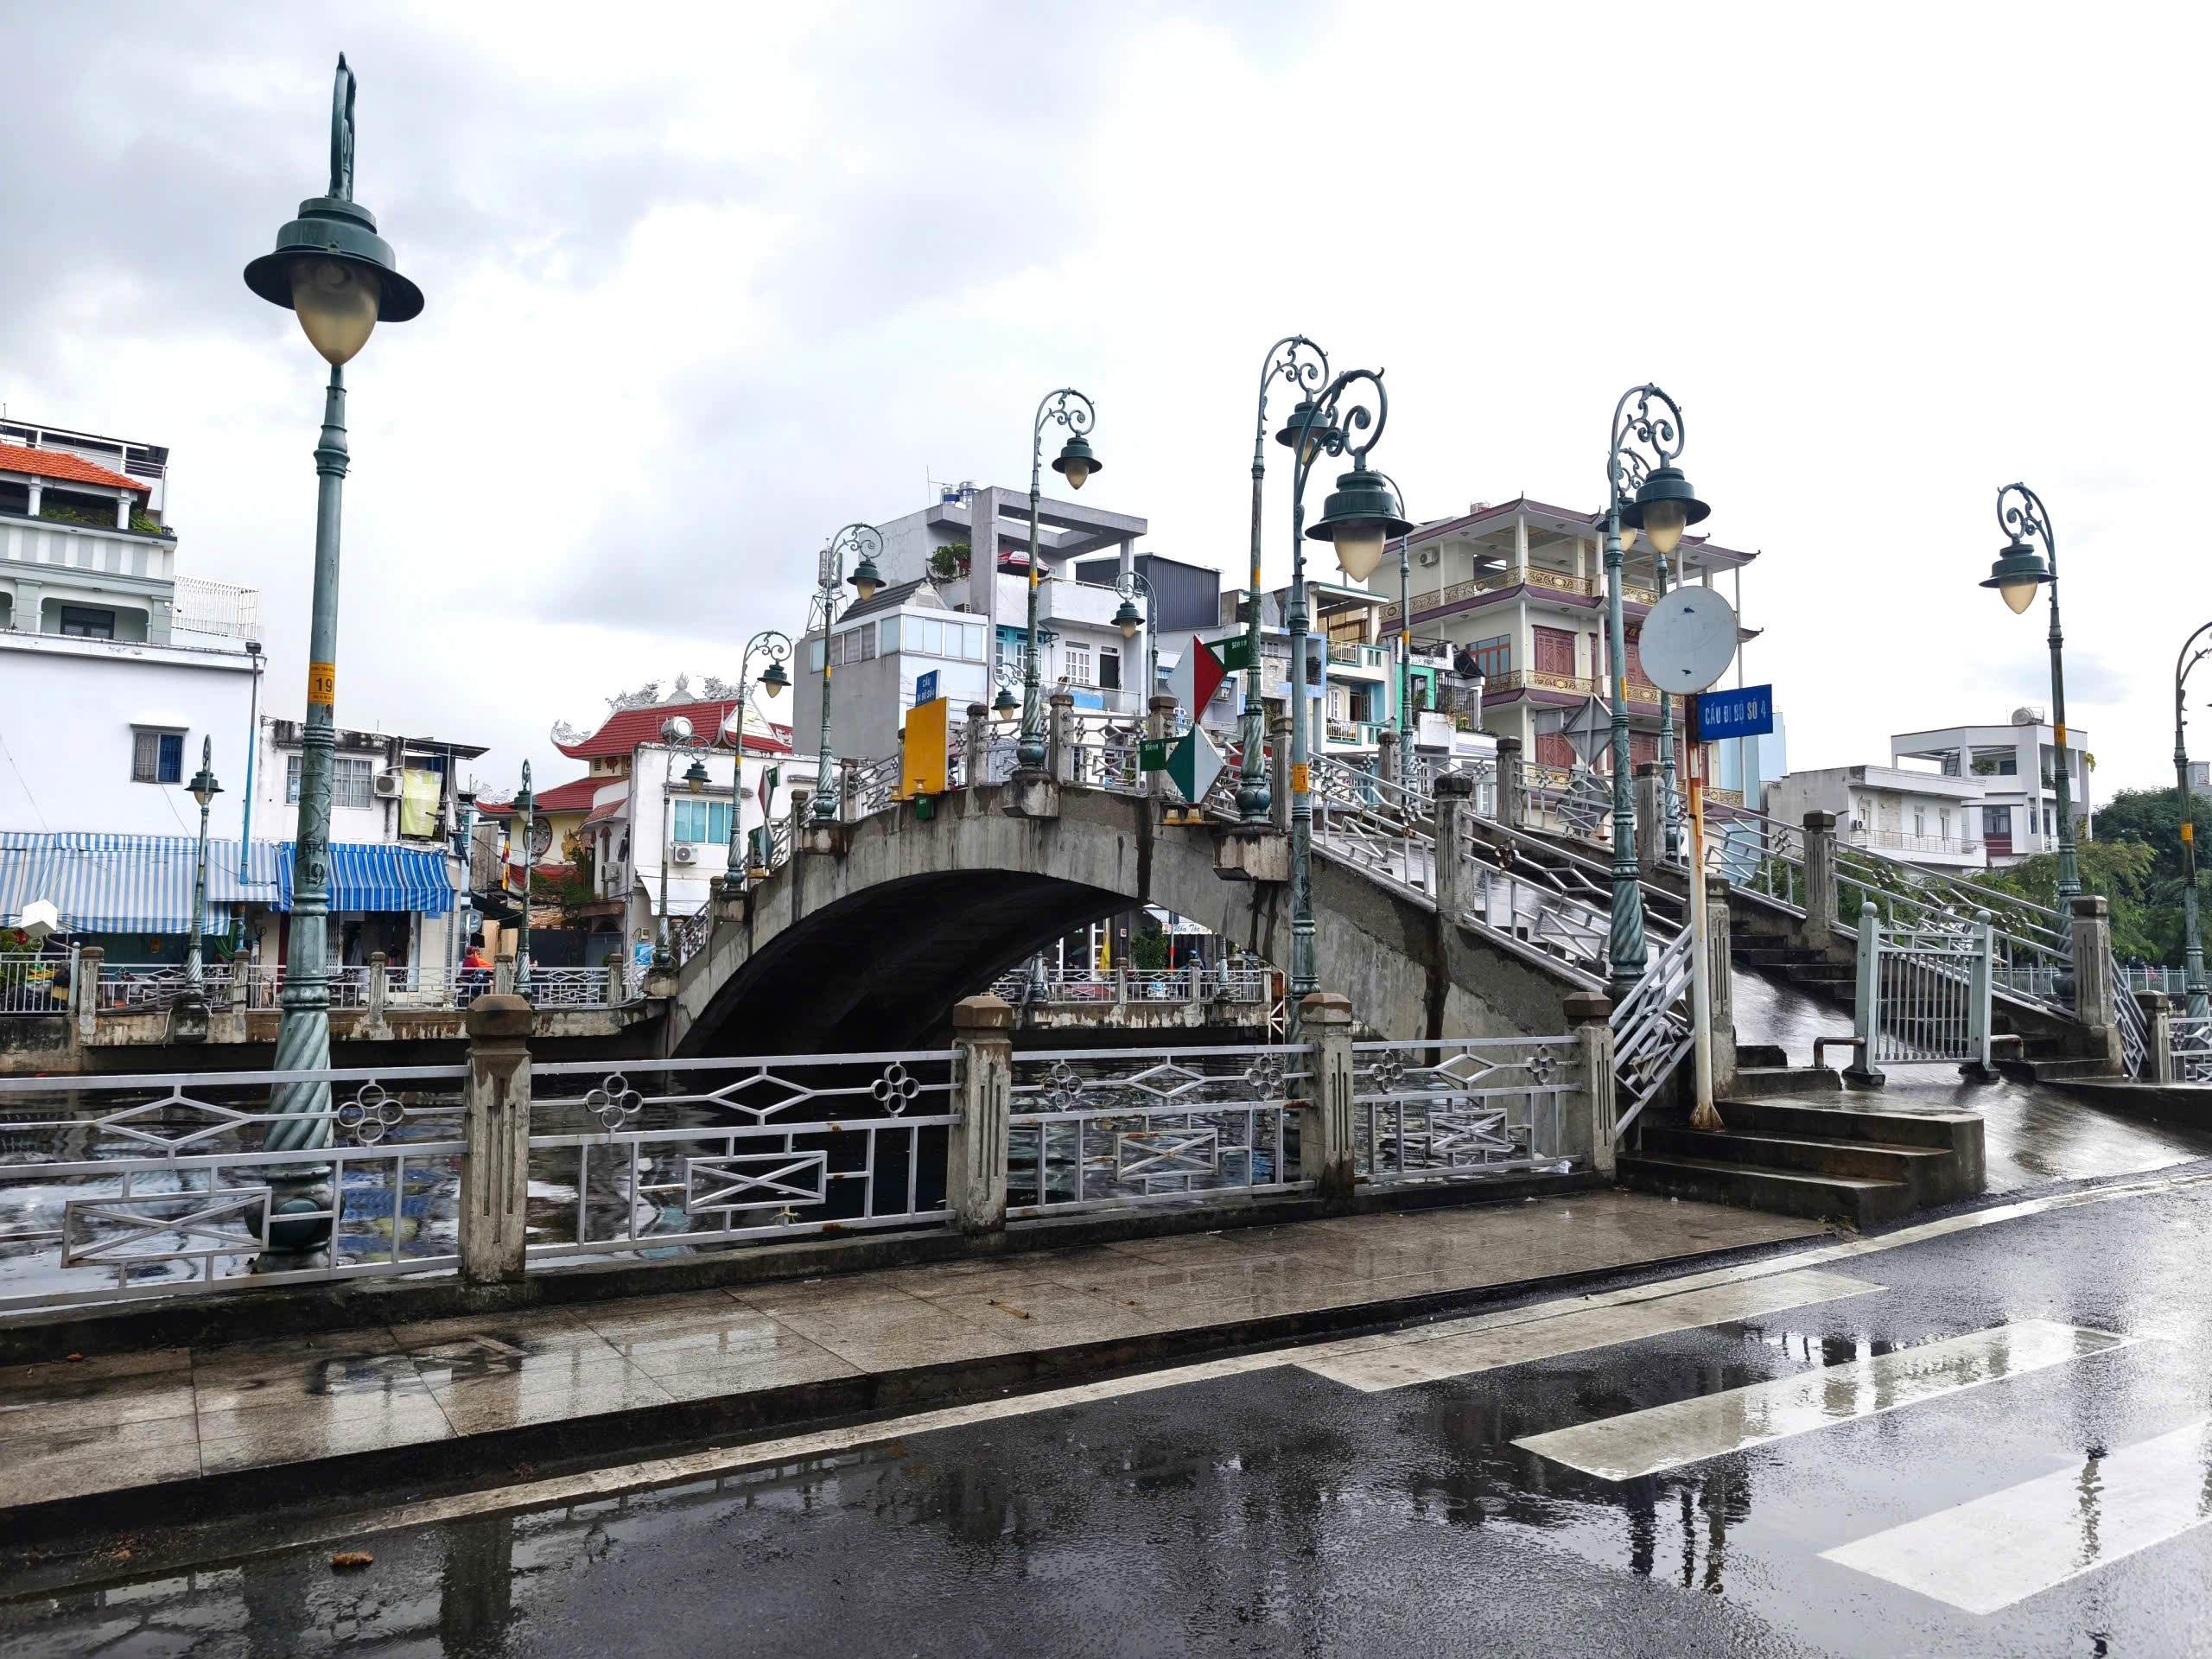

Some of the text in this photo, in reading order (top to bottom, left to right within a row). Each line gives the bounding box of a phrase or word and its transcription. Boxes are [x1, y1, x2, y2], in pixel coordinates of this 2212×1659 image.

[315, 677, 333, 693] 19
[1733, 699, 1745, 725] BỘ
[1760, 699, 1767, 719] 4
